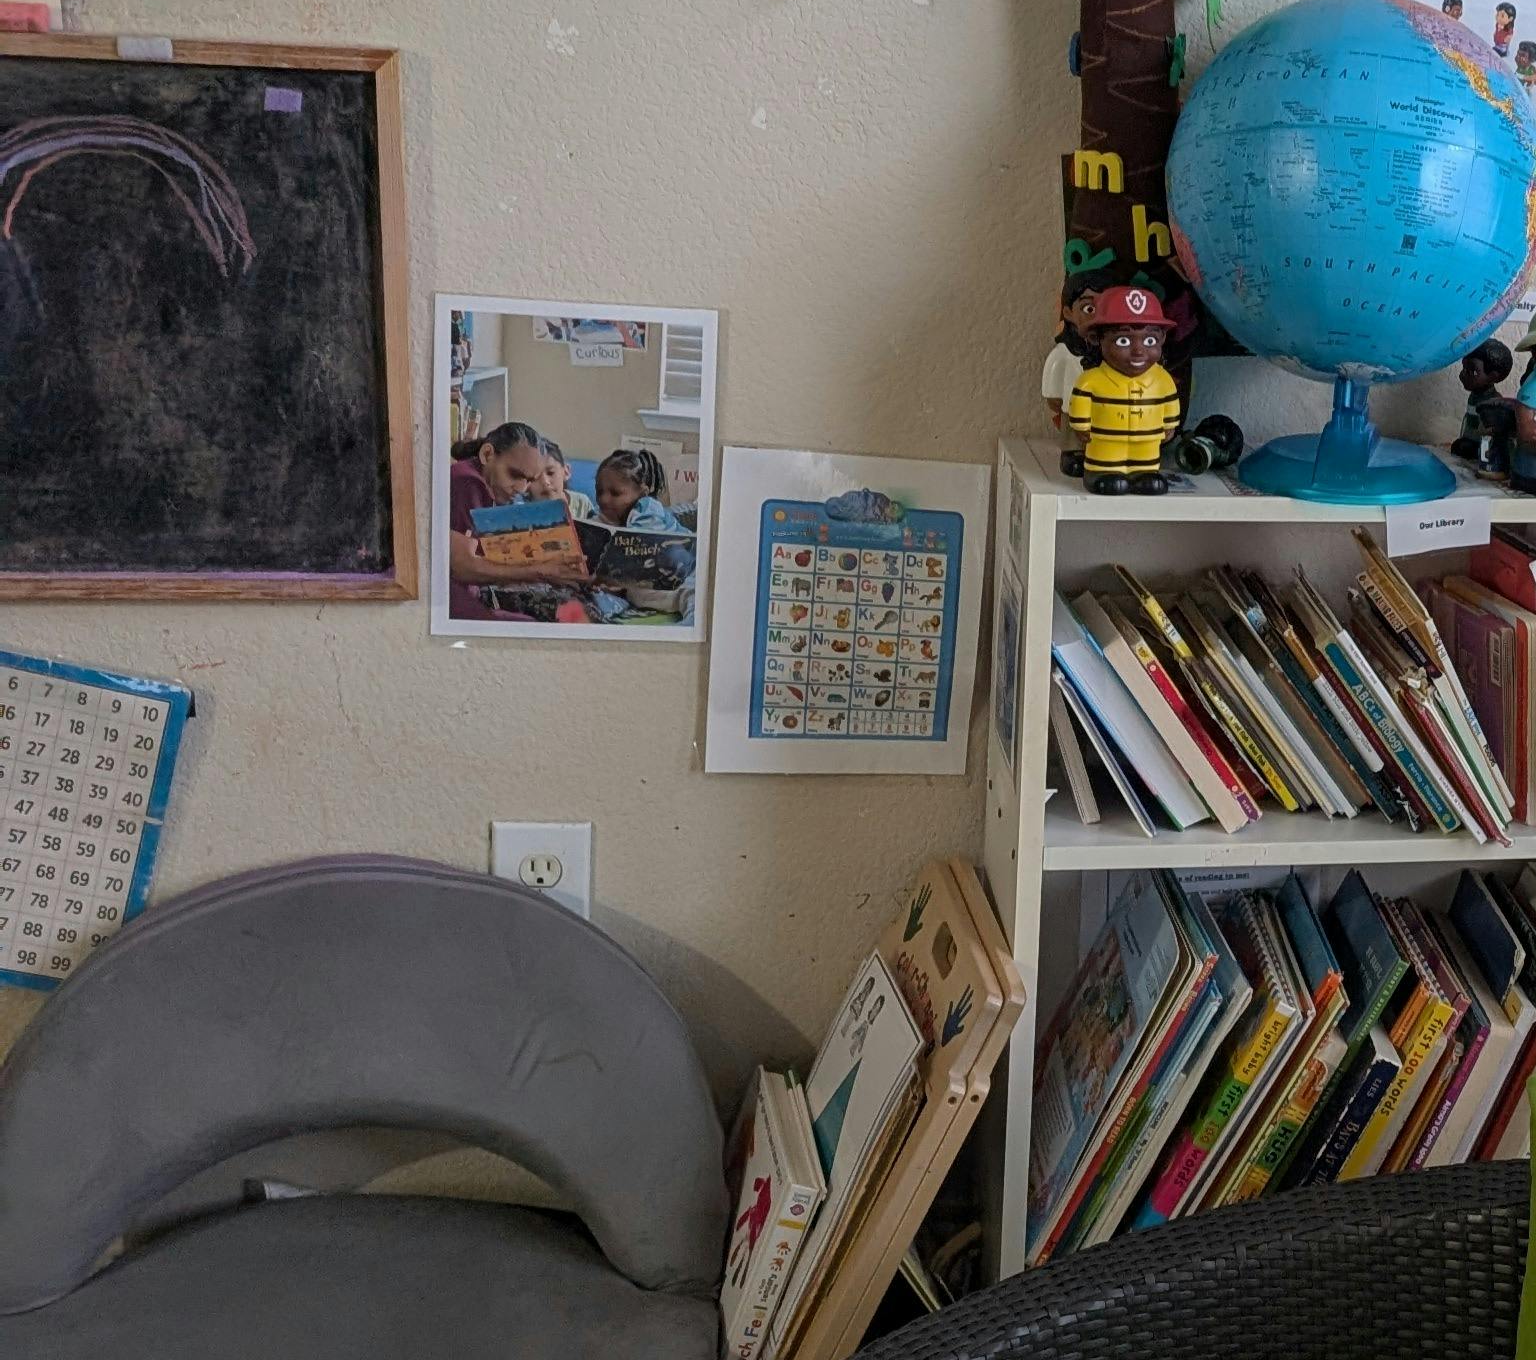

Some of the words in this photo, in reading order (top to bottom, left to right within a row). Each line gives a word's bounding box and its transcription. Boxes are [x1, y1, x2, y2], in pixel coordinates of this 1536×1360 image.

[1284, 69, 1371, 82] OCEAN
[1390, 100, 1418, 112] World
[1423, 106, 1464, 124] Discovery
[1285, 255, 1376, 274] SOUTH
[1342, 297, 1421, 321] OCEAN
[1419, 519, 1434, 530] Our
[1435, 518, 1465, 530] Library
[774, 546, 791, 559] Aa
[818, 550, 835, 562] Bb
[863, 553, 878, 565] Cc
[906, 555, 923, 568] Dd
[772, 574, 788, 587] Ee
[861, 579, 877, 594] Gg
[904, 582, 919, 594] Hh
[859, 608, 874, 621] Kk
[769, 631, 790, 642] Mm
[813, 633, 830, 646] Nn
[857, 636, 872, 648] Oo
[901, 639, 916, 651] Pp
[768, 658, 784, 672] Qq
[8, 677, 18, 690] 6
[43, 683, 54, 697] 7
[77, 692, 87, 706] 8
[111, 699, 122, 714] 9
[143, 706, 159, 723] 10
[766, 684, 782, 696] Uu
[811, 687, 825, 698] Vv
[854, 689, 872, 700] Ww
[1351, 680, 1379, 714] ABCs
[765, 709, 780, 723] Yy
[34, 712, 51, 728] 17
[69, 719, 85, 735] 18
[103, 727, 119, 743] 19
[134, 734, 154, 751] 20
[26, 741, 46, 758] 27
[60, 748, 80, 764] 28
[95, 755, 115, 771] 29
[128, 763, 148, 779] 30
[20, 770, 40, 786] 37
[54, 777, 75, 793] 38
[88, 783, 108, 800] 39
[122, 791, 143, 807] 40
[14, 799, 34, 816] 47
[48, 805, 69, 822] 48
[82, 813, 103, 829] 49
[116, 819, 136, 836] 50
[8, 829, 27, 844] 57
[41, 835, 62, 851] 58
[75, 842, 96, 858] 59
[110, 848, 131, 864] 60
[2, 857, 22, 873] 67
[35, 864, 56, 880] 68
[70, 871, 90, 887] 69
[104, 877, 124, 893] 70
[29, 893, 49, 908] 78
[63, 899, 83, 915] 79
[96, 905, 118, 921] 80
[23, 922, 43, 938] 88
[56, 928, 77, 944] 89
[17, 950, 37, 966] 98
[50, 956, 71, 972] 99
[1257, 1018, 1283, 1053] bright
[1418, 1017, 1444, 1051] first
[1241, 1049, 1264, 1078] baby
[1403, 1050, 1425, 1078] 100
[1216, 1082, 1245, 1120] first
[1365, 1076, 1383, 1099] LIES
[1379, 1076, 1409, 1118] words
[1262, 1124, 1293, 1166] HUG
[1173, 1147, 1205, 1189] words
